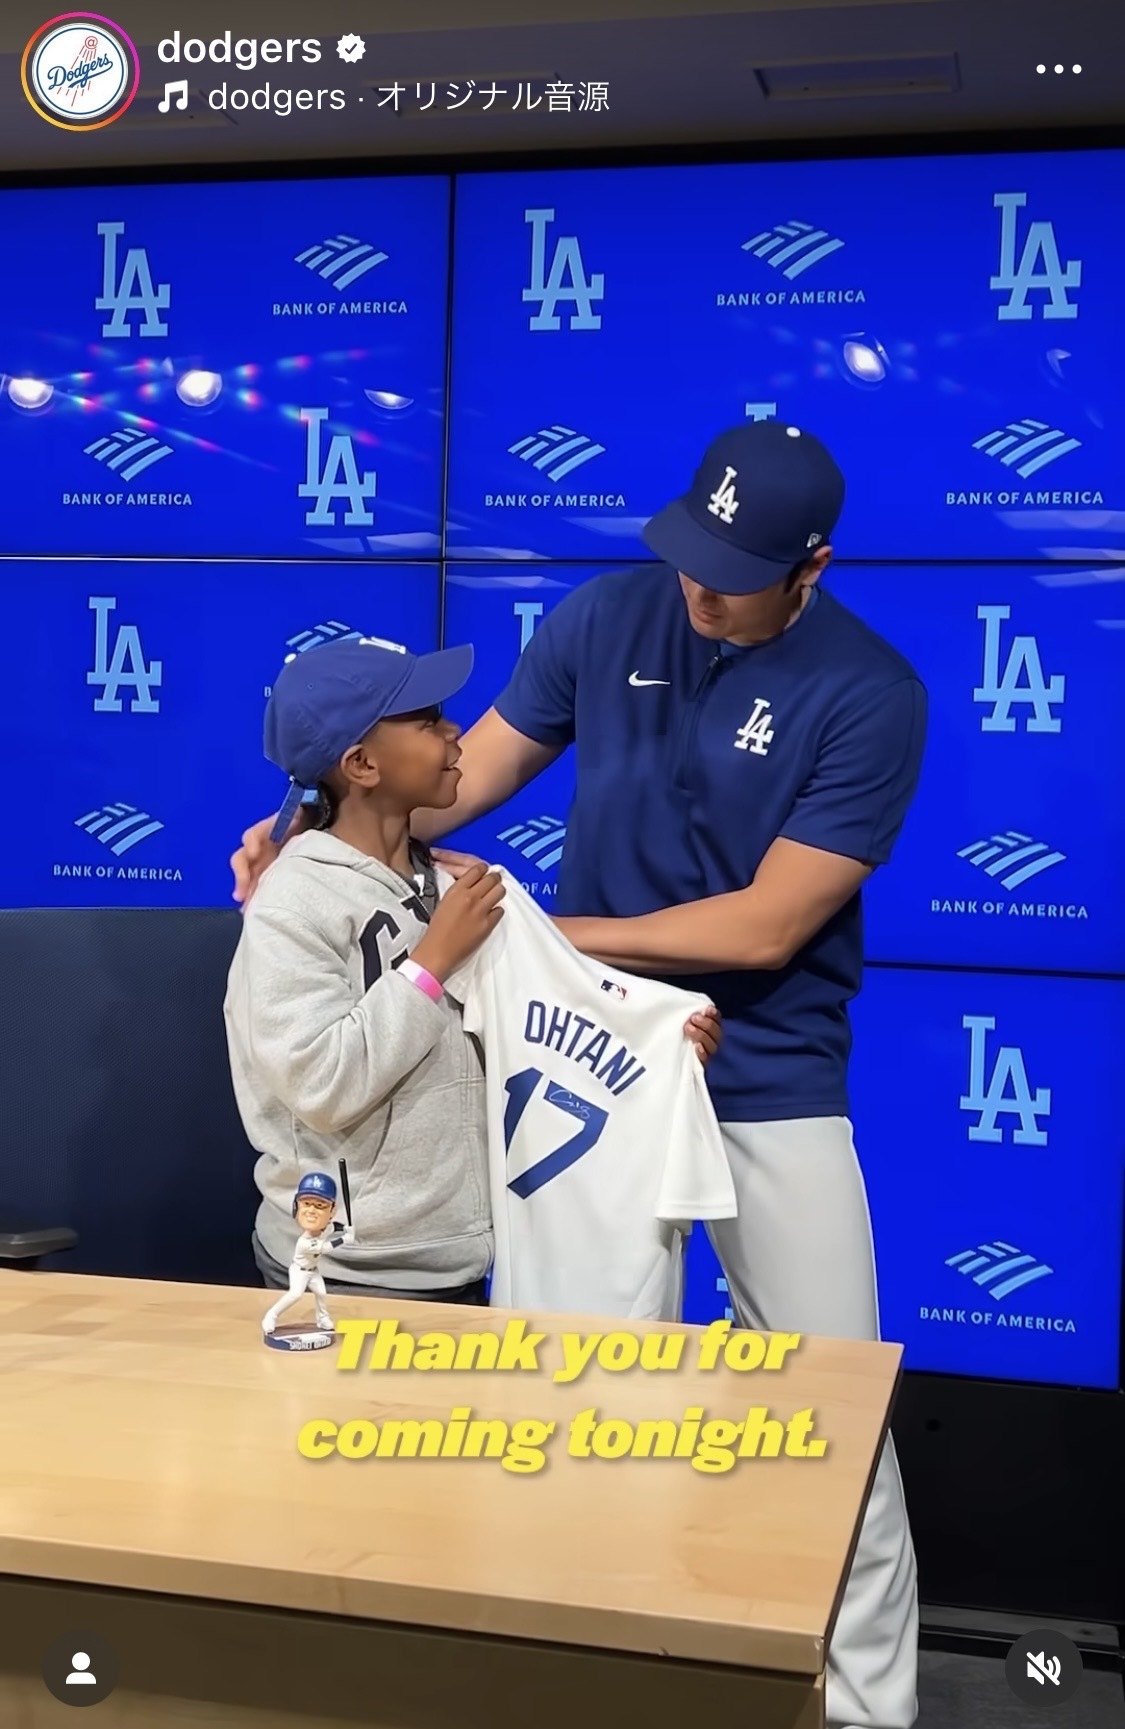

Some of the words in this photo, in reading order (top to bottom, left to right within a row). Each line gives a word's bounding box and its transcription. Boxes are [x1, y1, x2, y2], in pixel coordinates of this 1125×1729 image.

[95, 221, 171, 338] LA
[523, 208, 605, 331] LA
[990, 192, 1082, 320] LA
[272, 303, 313, 316] BANK
[316, 302, 336, 314] OF
[339, 301, 408, 315] AMERICA
[716, 293, 761, 306] BANK
[765, 292, 786, 304] OF
[789, 290, 866, 304] AMERICA
[298, 406, 377, 526] LA
[708, 465, 740, 525] LA
[62, 493, 102, 505] BANK
[105, 493, 124, 505] OF
[126, 493, 193, 506] AMERICA
[485, 494, 527, 507] BANK
[530, 494, 551, 507] OF
[553, 494, 626, 507] AMERICA
[946, 491, 993, 505] BANK
[997, 491, 1020, 505] OF
[1023, 491, 1104, 505] AMERICA
[87, 596, 162, 713] LA
[973, 605, 1065, 733] LA
[733, 697, 775, 756] LA
[53, 864, 92, 877] BANK
[95, 866, 114, 878] OF
[116, 867, 183, 881] AMERICA
[931, 899, 977, 914] BANK
[982, 902, 1004, 915] OF
[1007, 903, 1088, 919] AMERICA
[524, 1000, 646, 1097] OHTANI
[960, 1014, 1051, 1146] LA
[504, 1066, 610, 1200] 17
[920, 1306, 966, 1323] BANK
[970, 1311, 993, 1325] OF
[996, 1313, 1077, 1333] AMERICA
